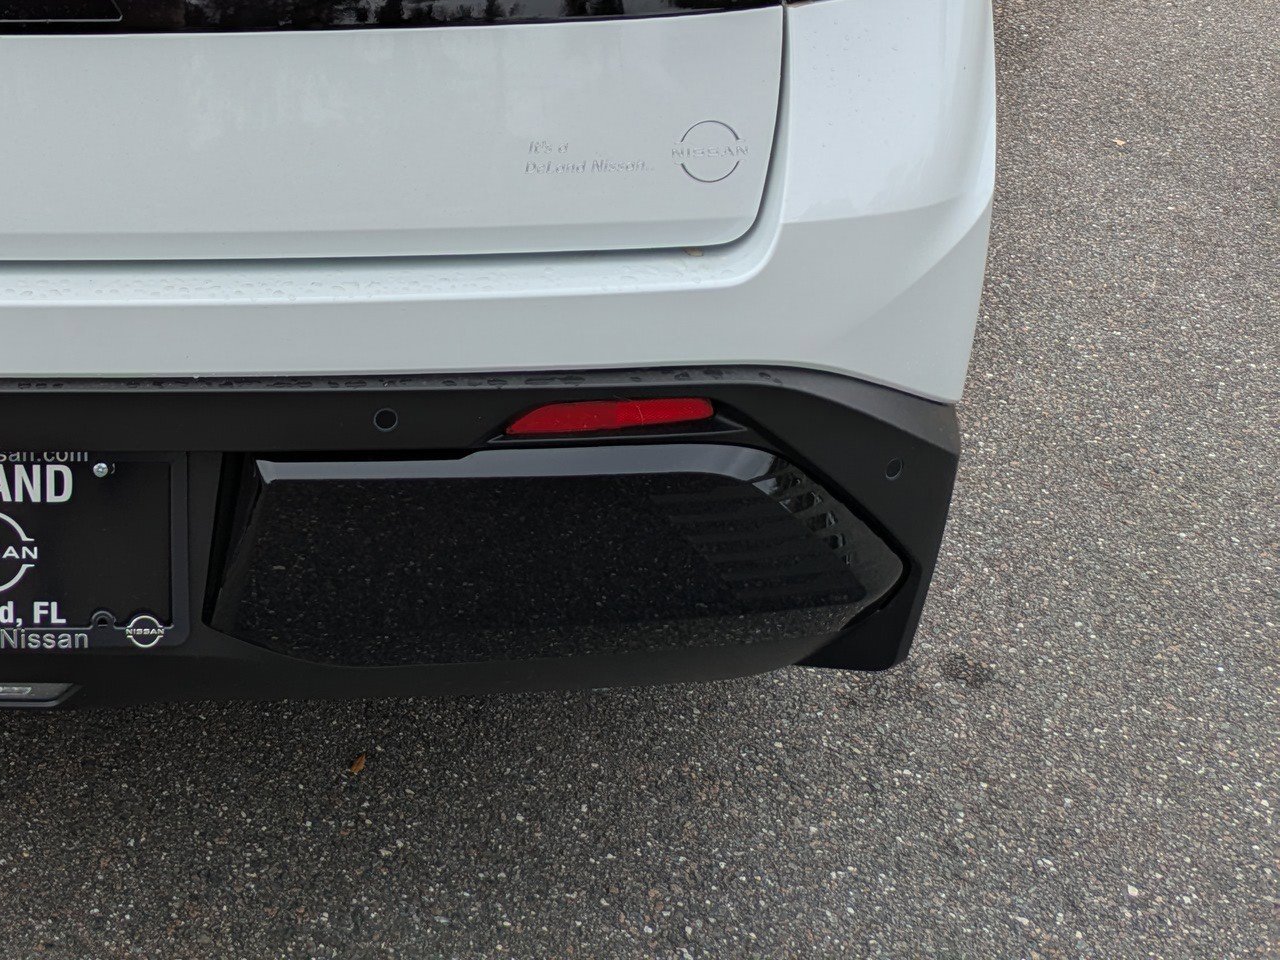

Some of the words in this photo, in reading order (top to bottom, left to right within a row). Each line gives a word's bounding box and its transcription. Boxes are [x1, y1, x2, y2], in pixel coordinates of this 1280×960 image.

[527, 140, 552, 154] It's
[558, 142, 569, 154] a
[671, 145, 749, 159] NISSAN
[524, 160, 586, 175] DeLand
[33, 601, 67, 624] FL
[126, 627, 164, 636] NISSAN
[0, 629, 89, 649] Nissan
